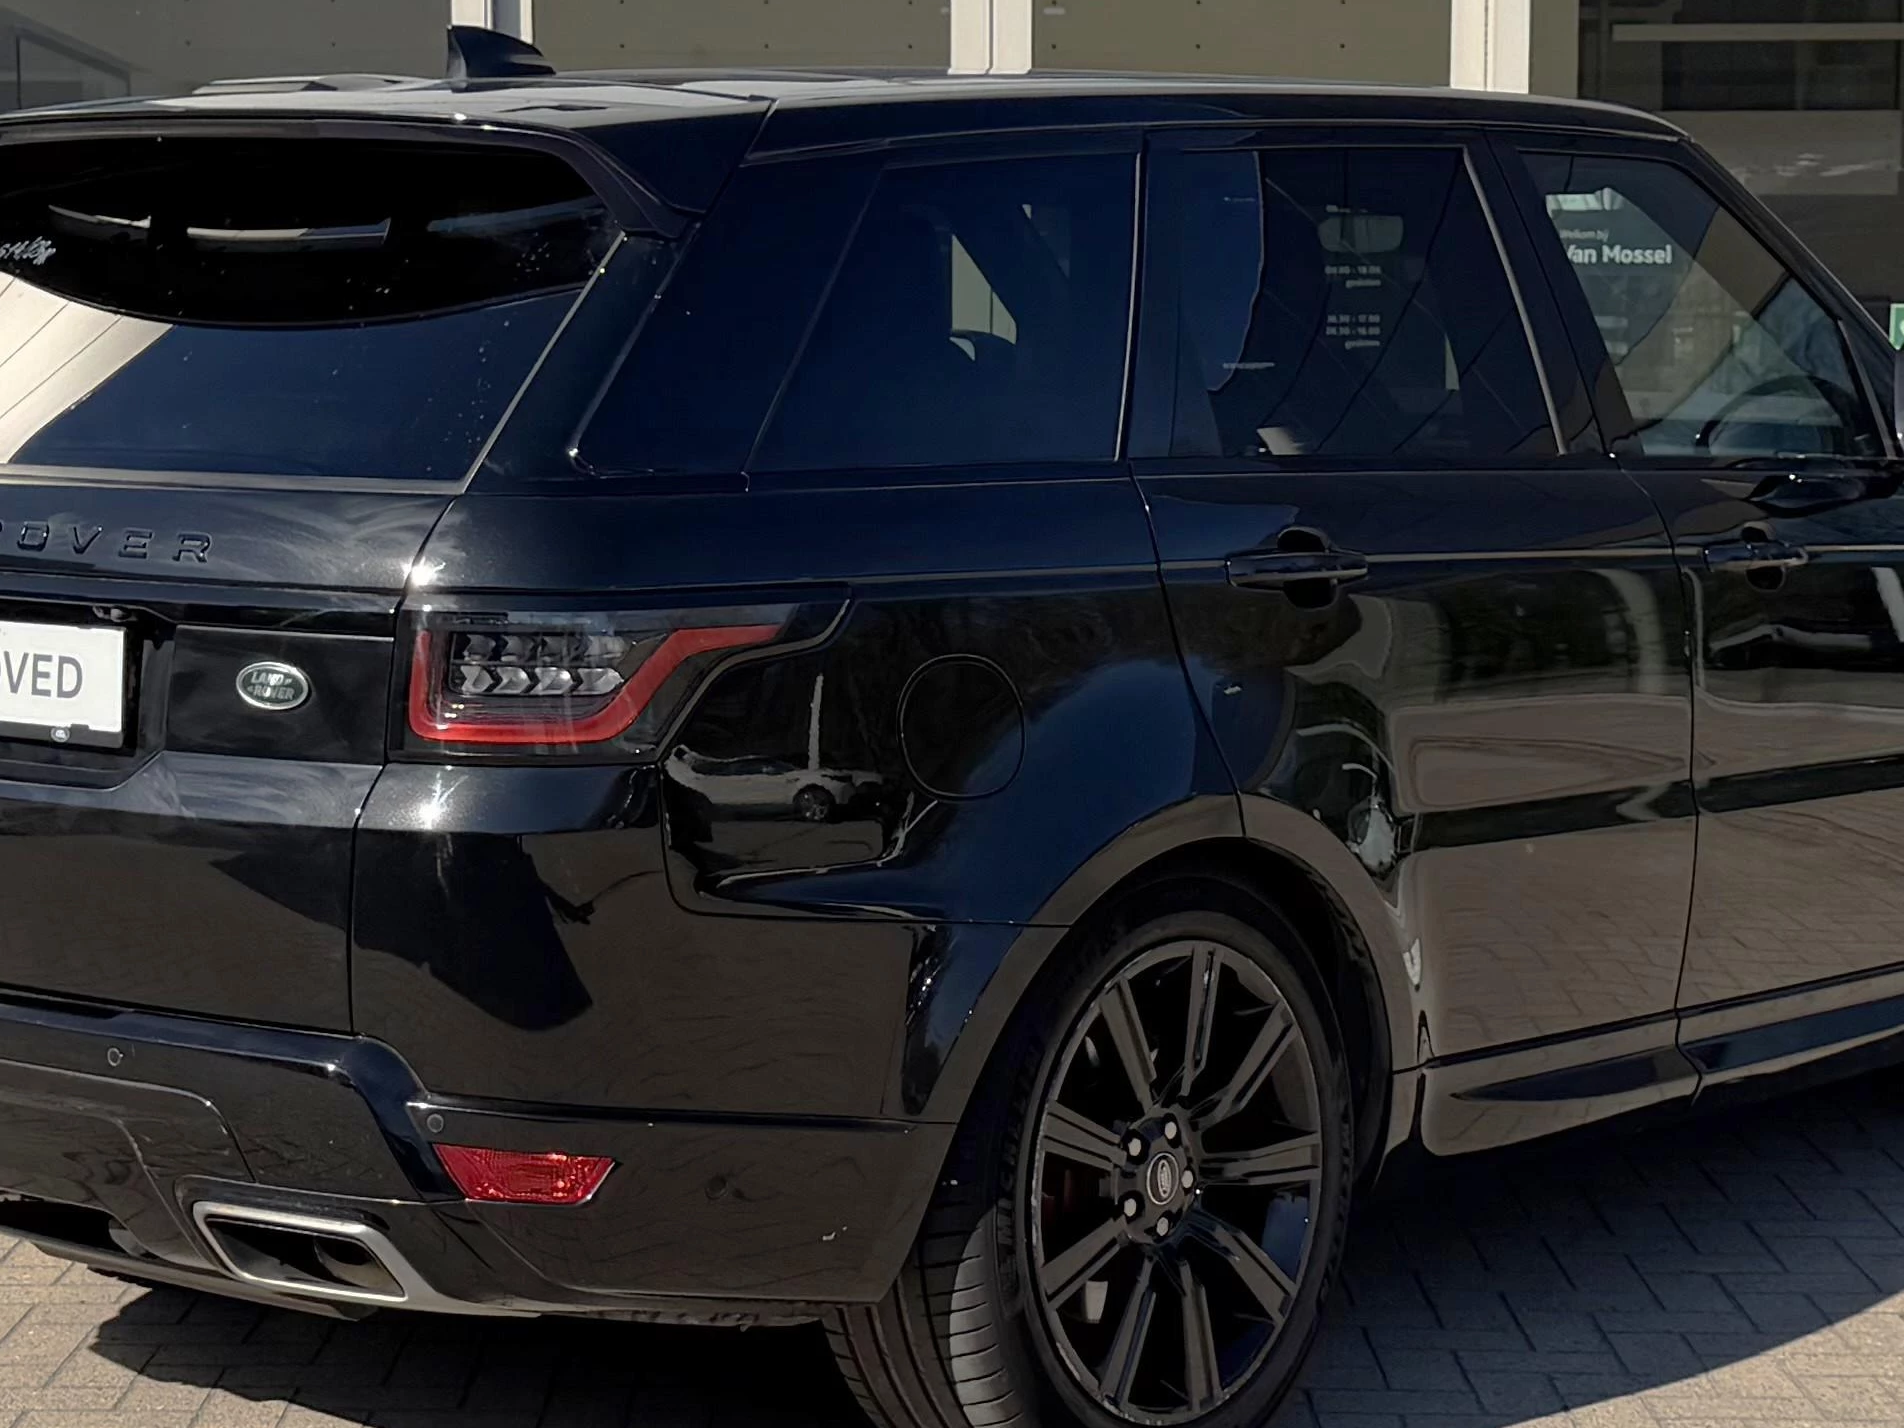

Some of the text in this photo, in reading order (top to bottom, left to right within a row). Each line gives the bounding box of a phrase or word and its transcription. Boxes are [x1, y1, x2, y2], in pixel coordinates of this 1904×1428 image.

[1601, 243, 1672, 264] Mossel
[251, 671, 284, 686] LAND
[253, 684, 295, 700] ROVER
